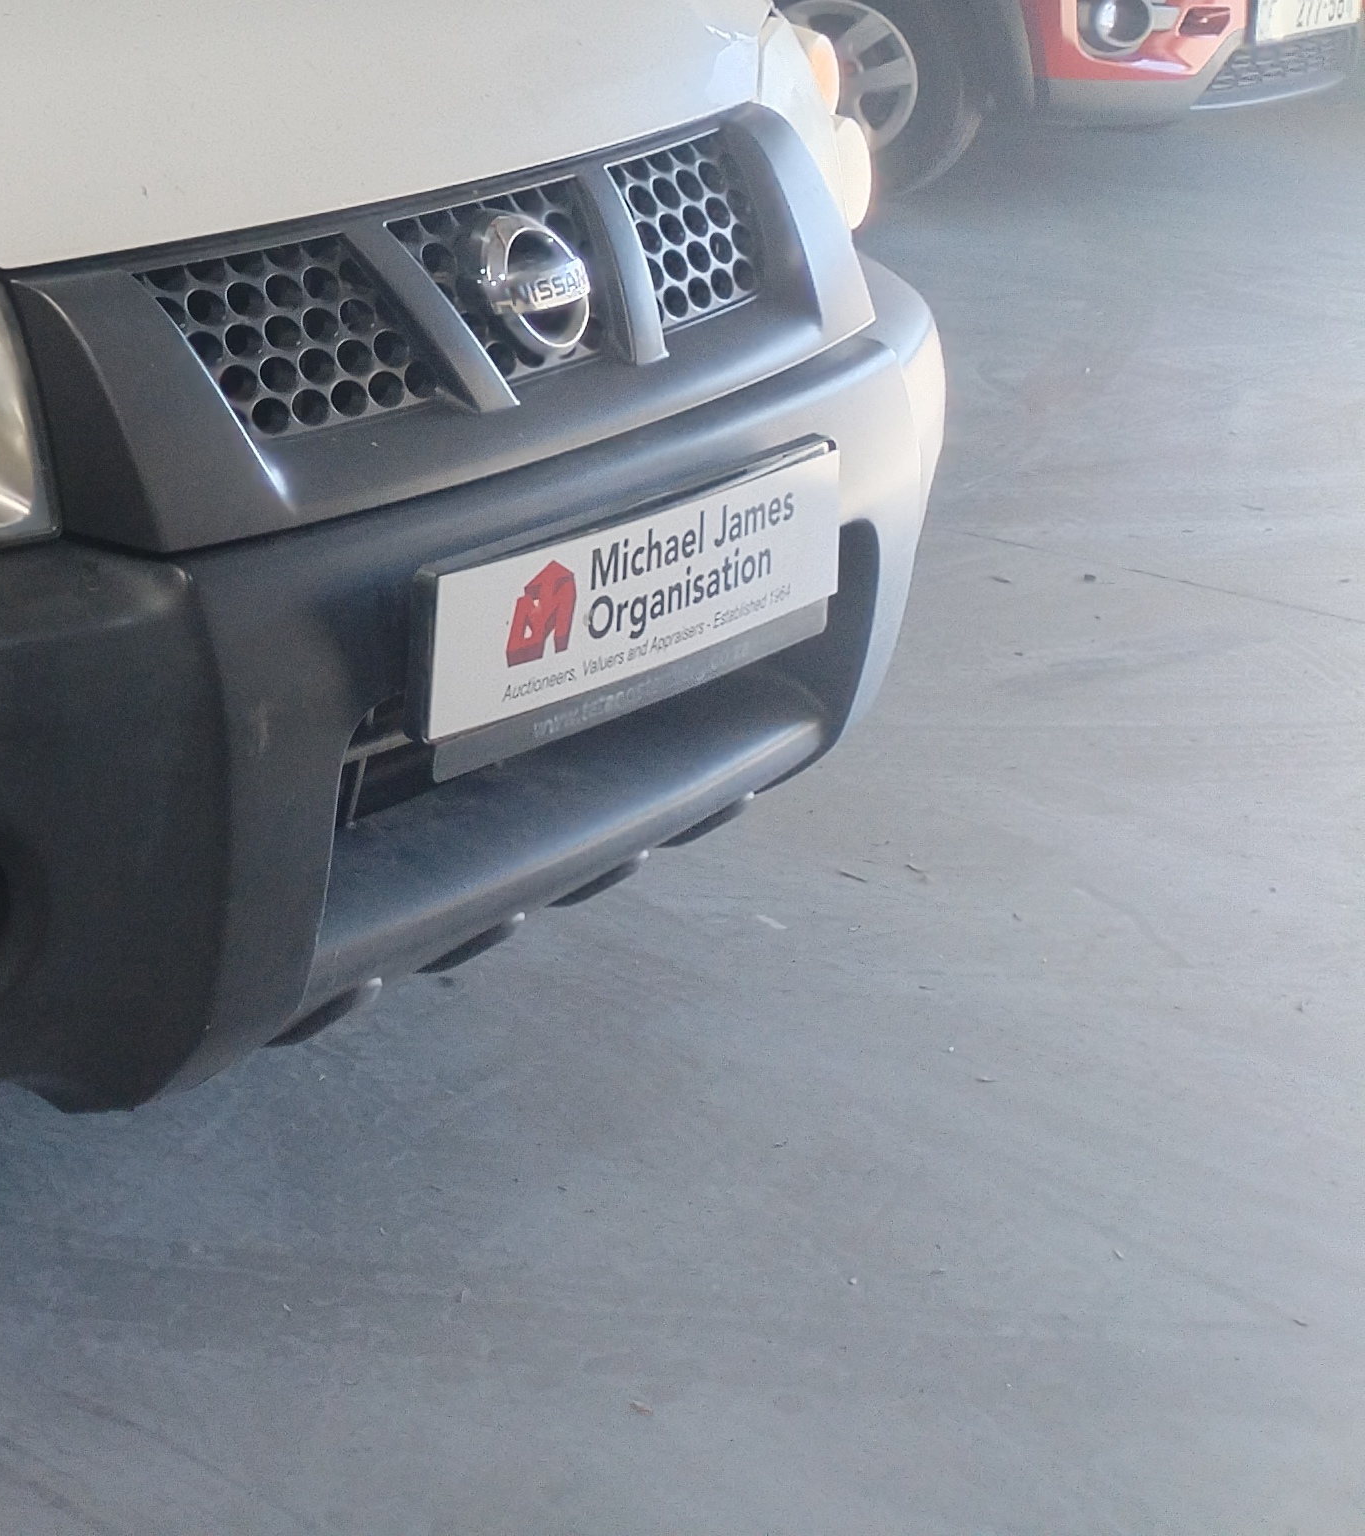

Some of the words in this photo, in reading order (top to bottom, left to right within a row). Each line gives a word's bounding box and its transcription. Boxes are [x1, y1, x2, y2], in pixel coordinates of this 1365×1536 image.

[590, 510, 706, 591] Michael
[714, 491, 795, 548] James
[587, 547, 772, 640] Organisation
[501, 666, 577, 703] Auctioneers,
[582, 651, 625, 677] Valuers
[627, 640, 649, 663] and
[648, 622, 705, 655] Appraisers
